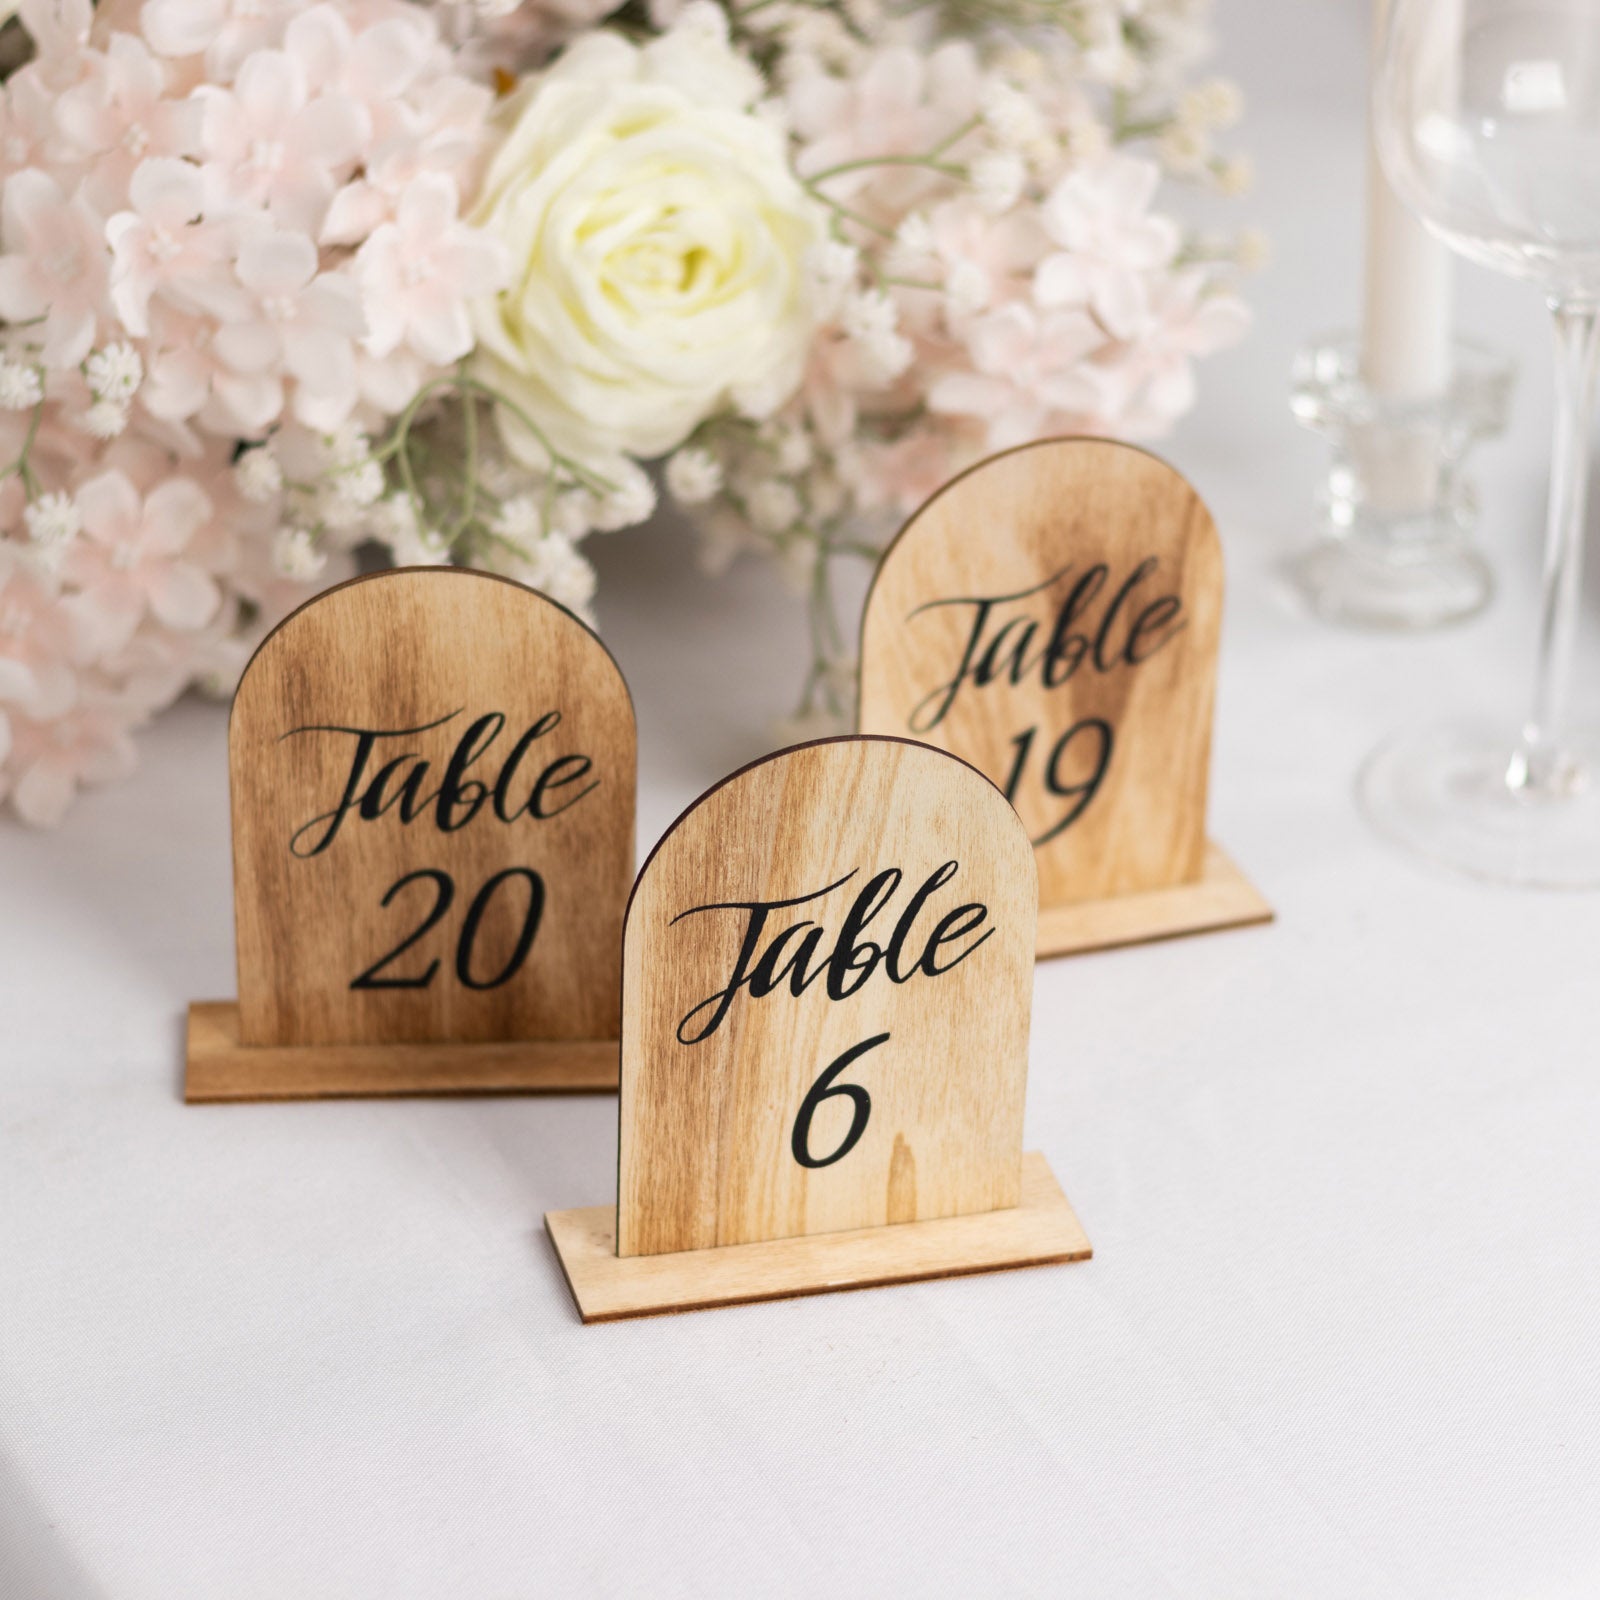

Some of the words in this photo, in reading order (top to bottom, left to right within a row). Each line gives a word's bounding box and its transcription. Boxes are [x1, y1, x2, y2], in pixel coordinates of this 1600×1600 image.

[905, 556, 1188, 735] Table
[278, 708, 600, 858] Table
[1002, 716, 1115, 848] 19
[348, 866, 546, 992] 20
[670, 860, 996, 1046] Table
[791, 1032, 891, 1169] 6
